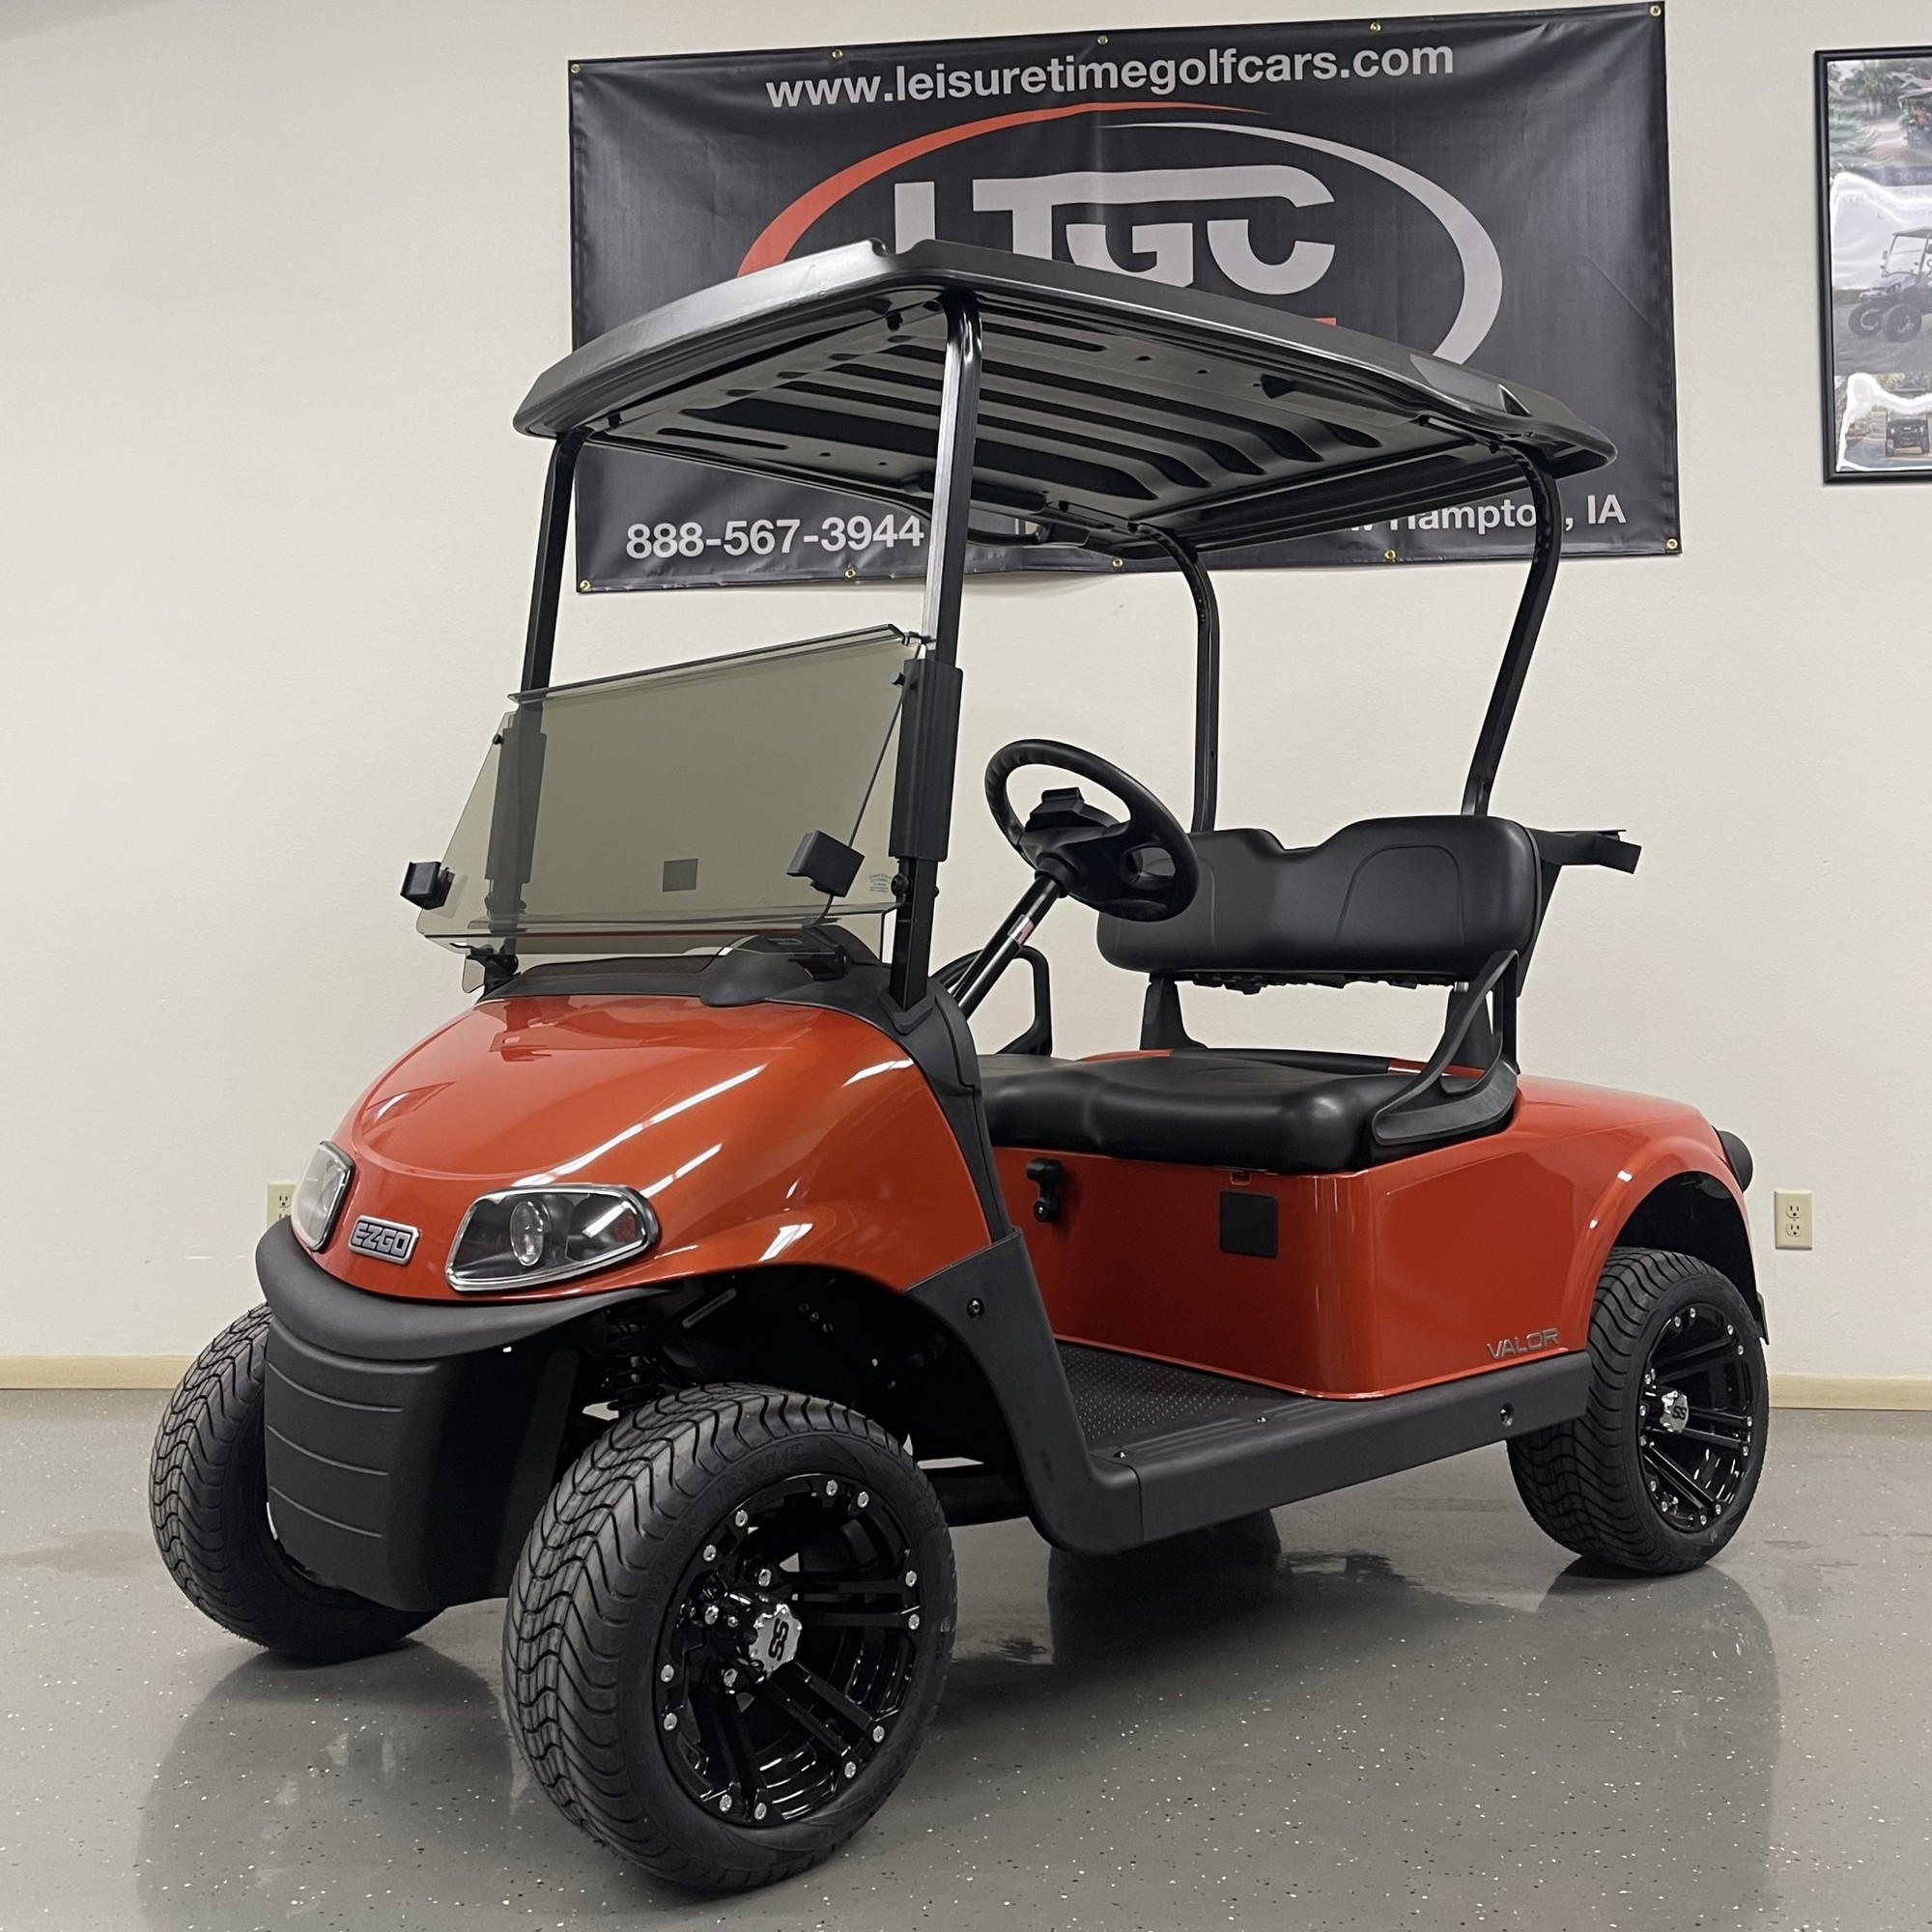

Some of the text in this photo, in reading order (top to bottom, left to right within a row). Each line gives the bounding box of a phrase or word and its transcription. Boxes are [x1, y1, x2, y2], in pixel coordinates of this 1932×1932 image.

[766, 45, 1454, 108] www.leisuretimegolfcars.com
[1390, 494, 1627, 535] ampto, IA
[626, 514, 924, 559] 888-567-3944
[351, 1221, 412, 1258] EZGO
[1486, 1327, 1559, 1360] VALOR
